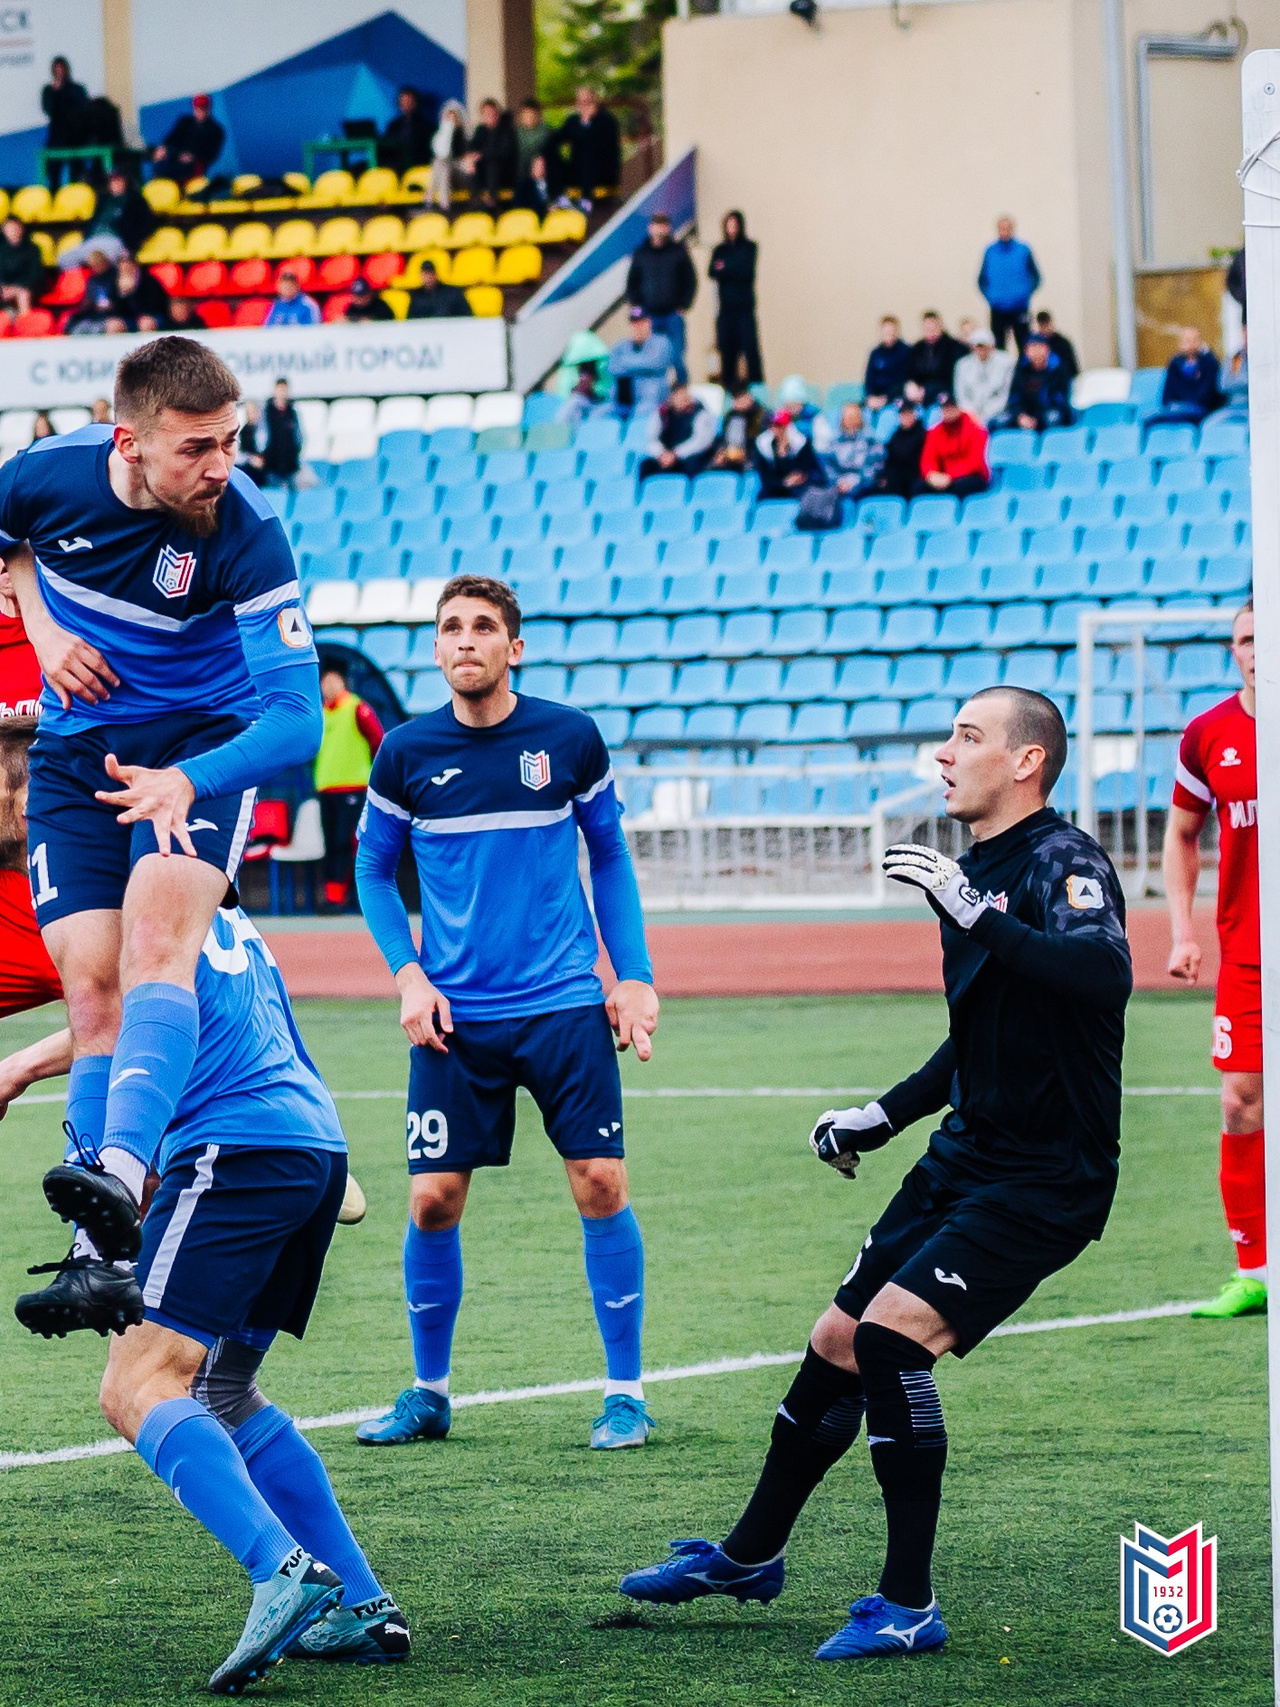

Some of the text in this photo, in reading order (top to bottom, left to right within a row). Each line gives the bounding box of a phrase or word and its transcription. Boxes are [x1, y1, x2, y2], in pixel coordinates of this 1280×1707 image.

[29, 358, 49, 386] С
[347, 344, 443, 371] ГОРОД!
[407, 1109, 448, 1160] 29
